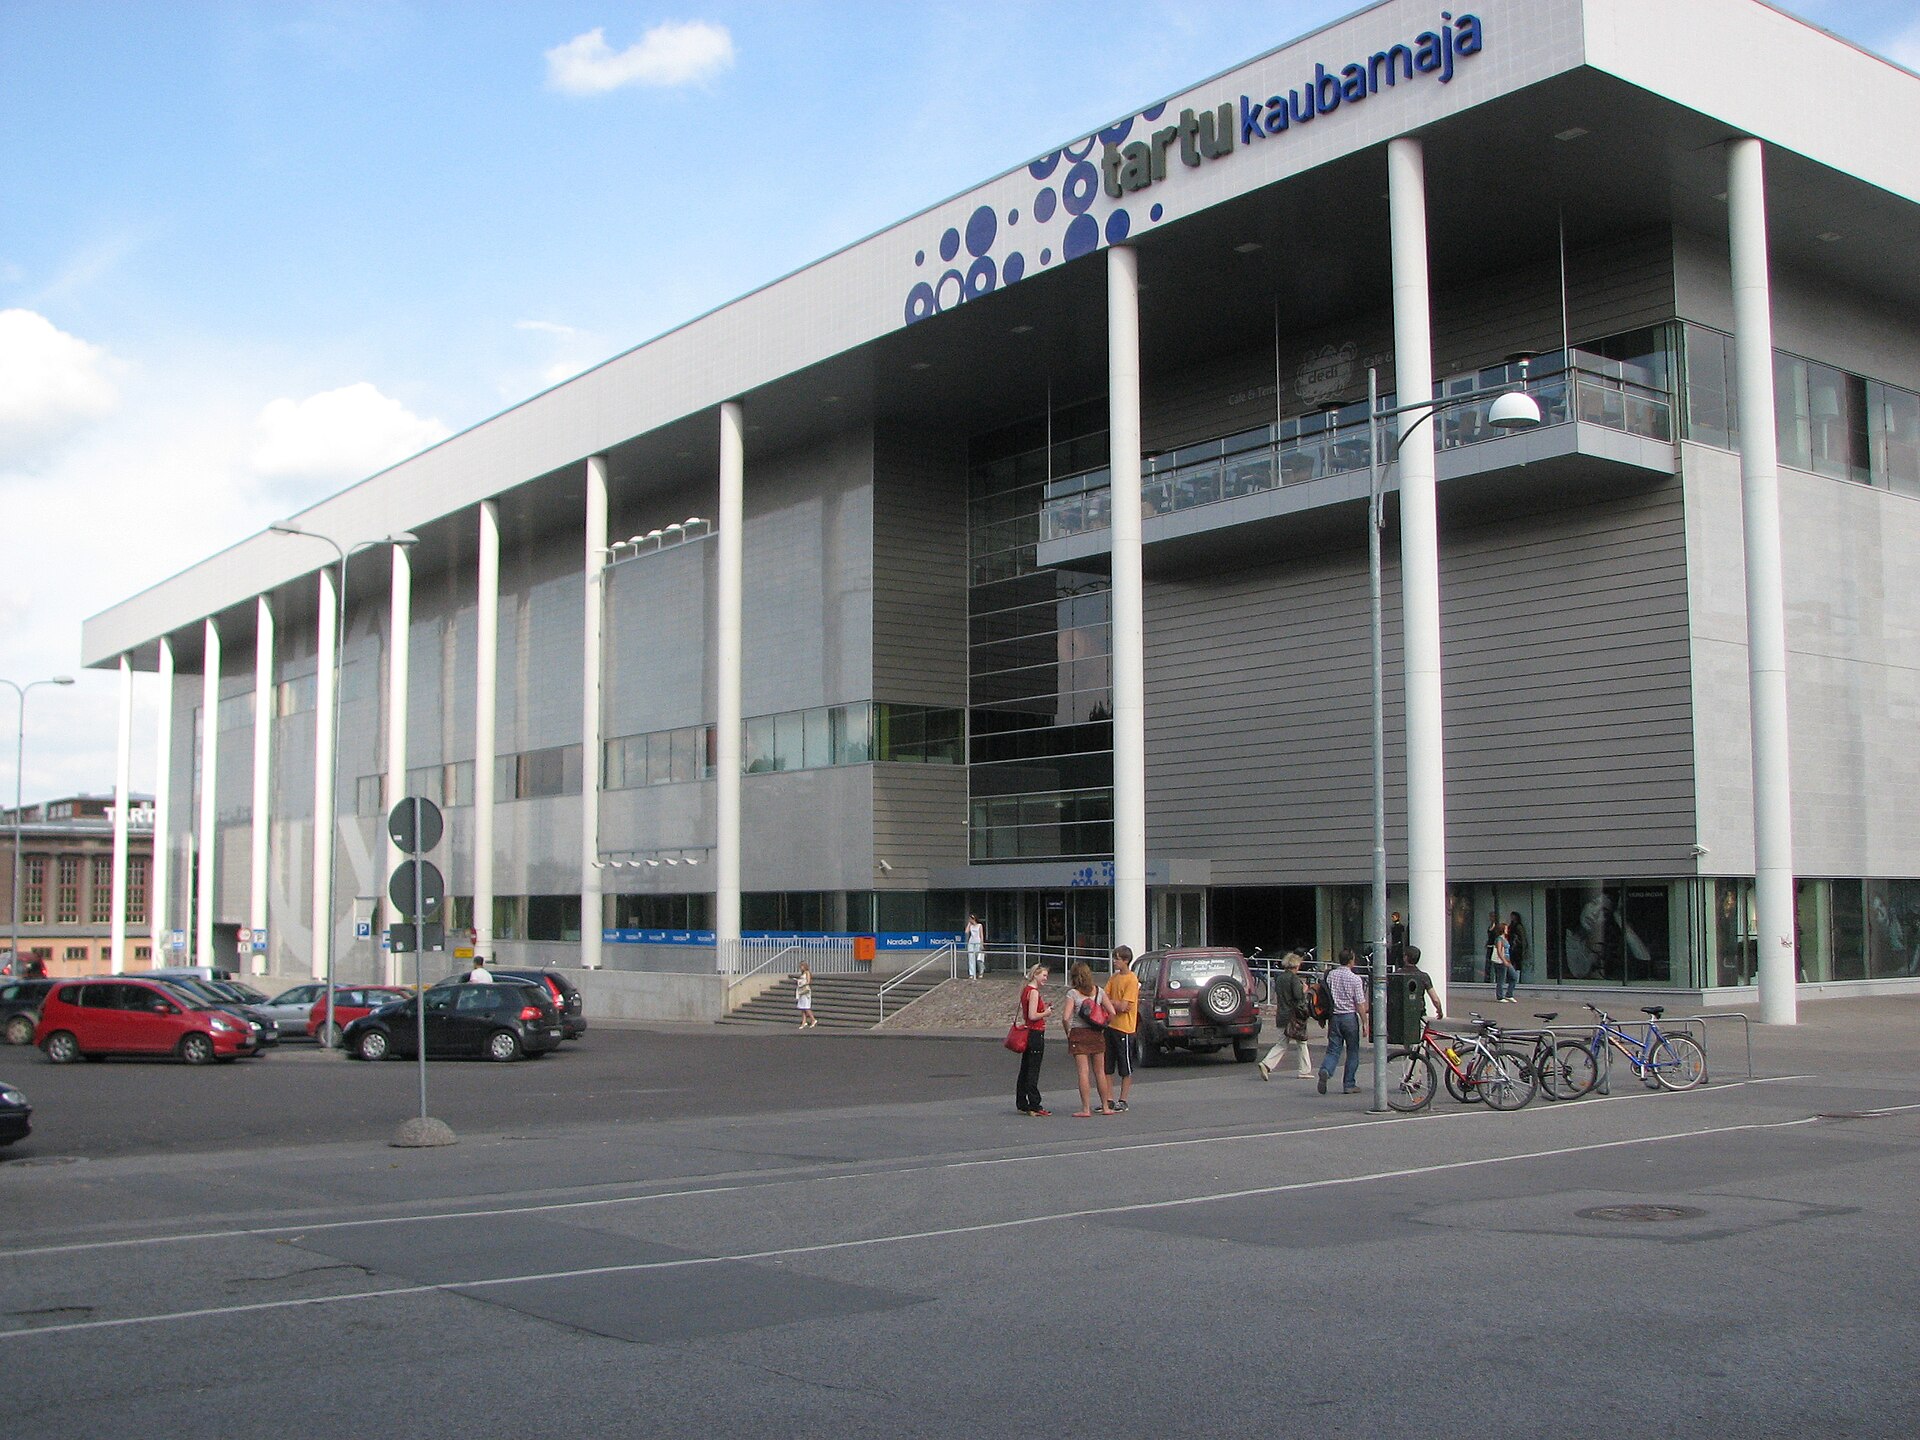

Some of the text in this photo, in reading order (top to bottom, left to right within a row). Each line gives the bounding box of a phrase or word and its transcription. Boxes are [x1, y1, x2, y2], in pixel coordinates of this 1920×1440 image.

[1100, 11, 1483, 199] tartu kaubamaja
[360, 925, 367, 935] P
[886, 938, 913, 946] Nordea
